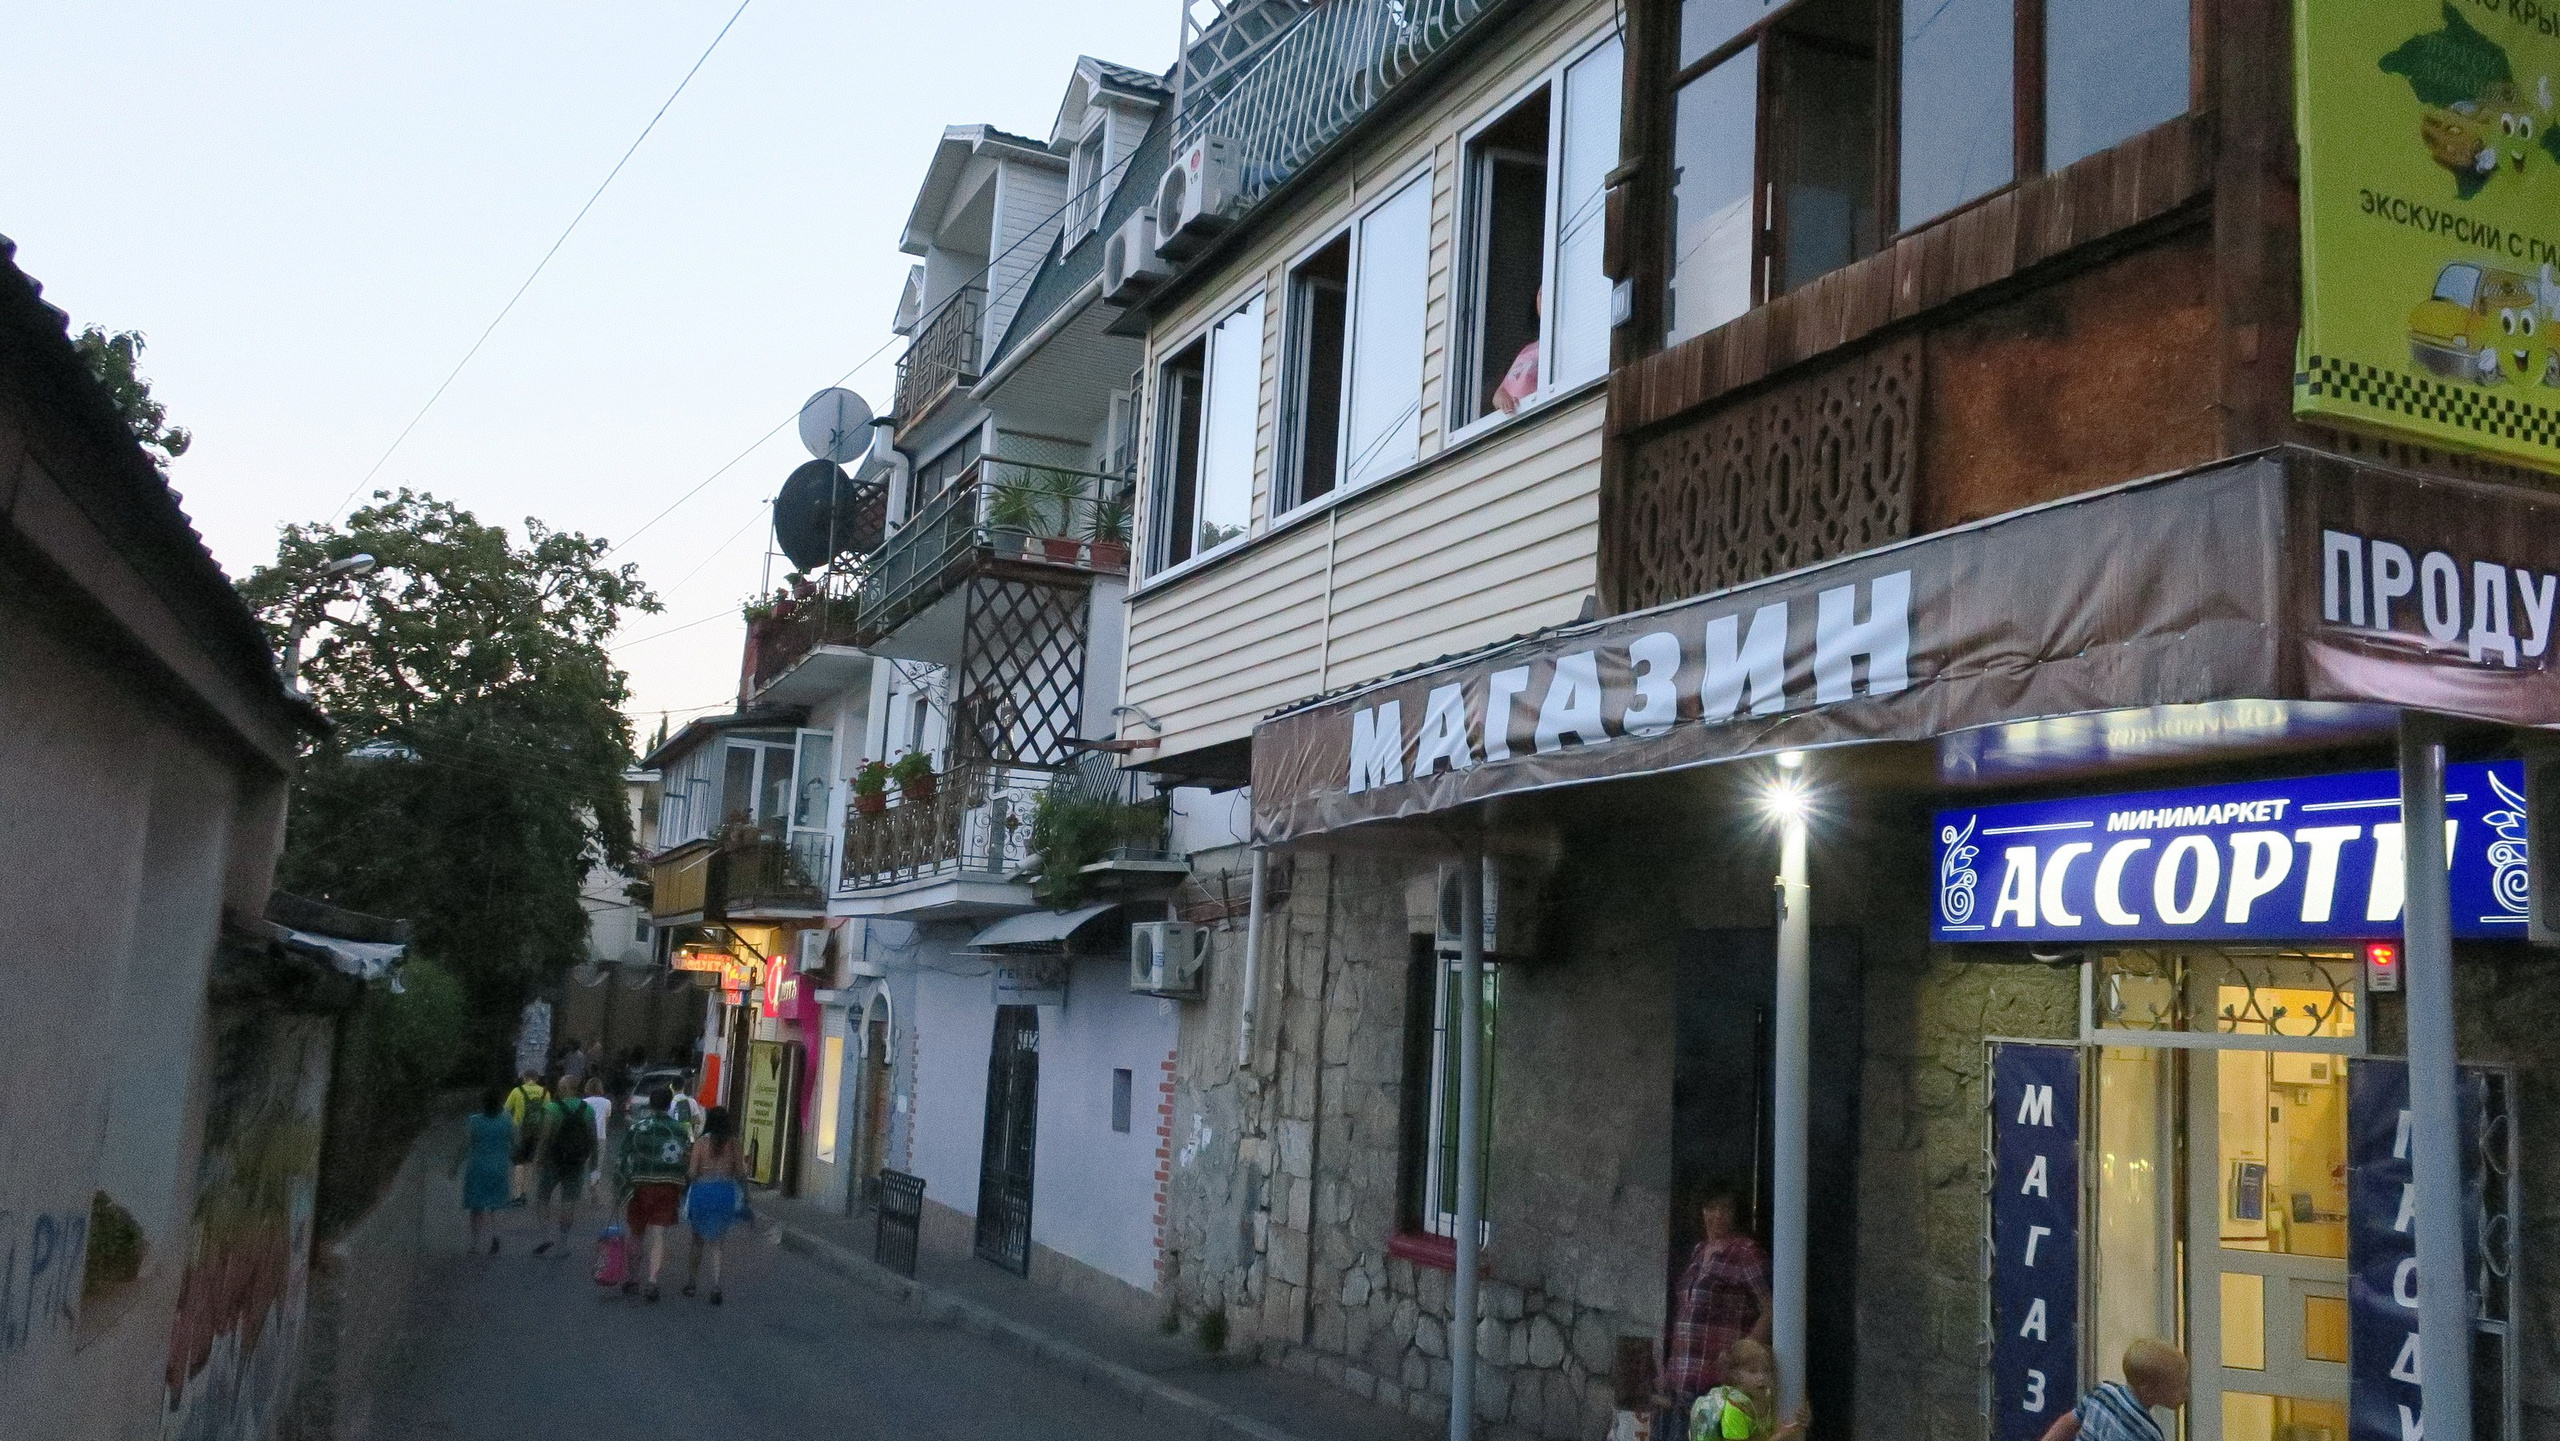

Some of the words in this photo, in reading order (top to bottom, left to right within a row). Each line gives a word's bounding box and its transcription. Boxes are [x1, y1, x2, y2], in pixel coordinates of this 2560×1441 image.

[2360, 188, 2501, 252] ЭКСКУРСИИ
[2507, 233, 2523, 257] С
[2529, 238, 2560, 272] ГИ
[2323, 529, 2557, 668] ПРОДУ
[1348, 569, 1912, 794] МАГАЗИН
[2106, 798, 2291, 832] МИНИМАРКЕТ
